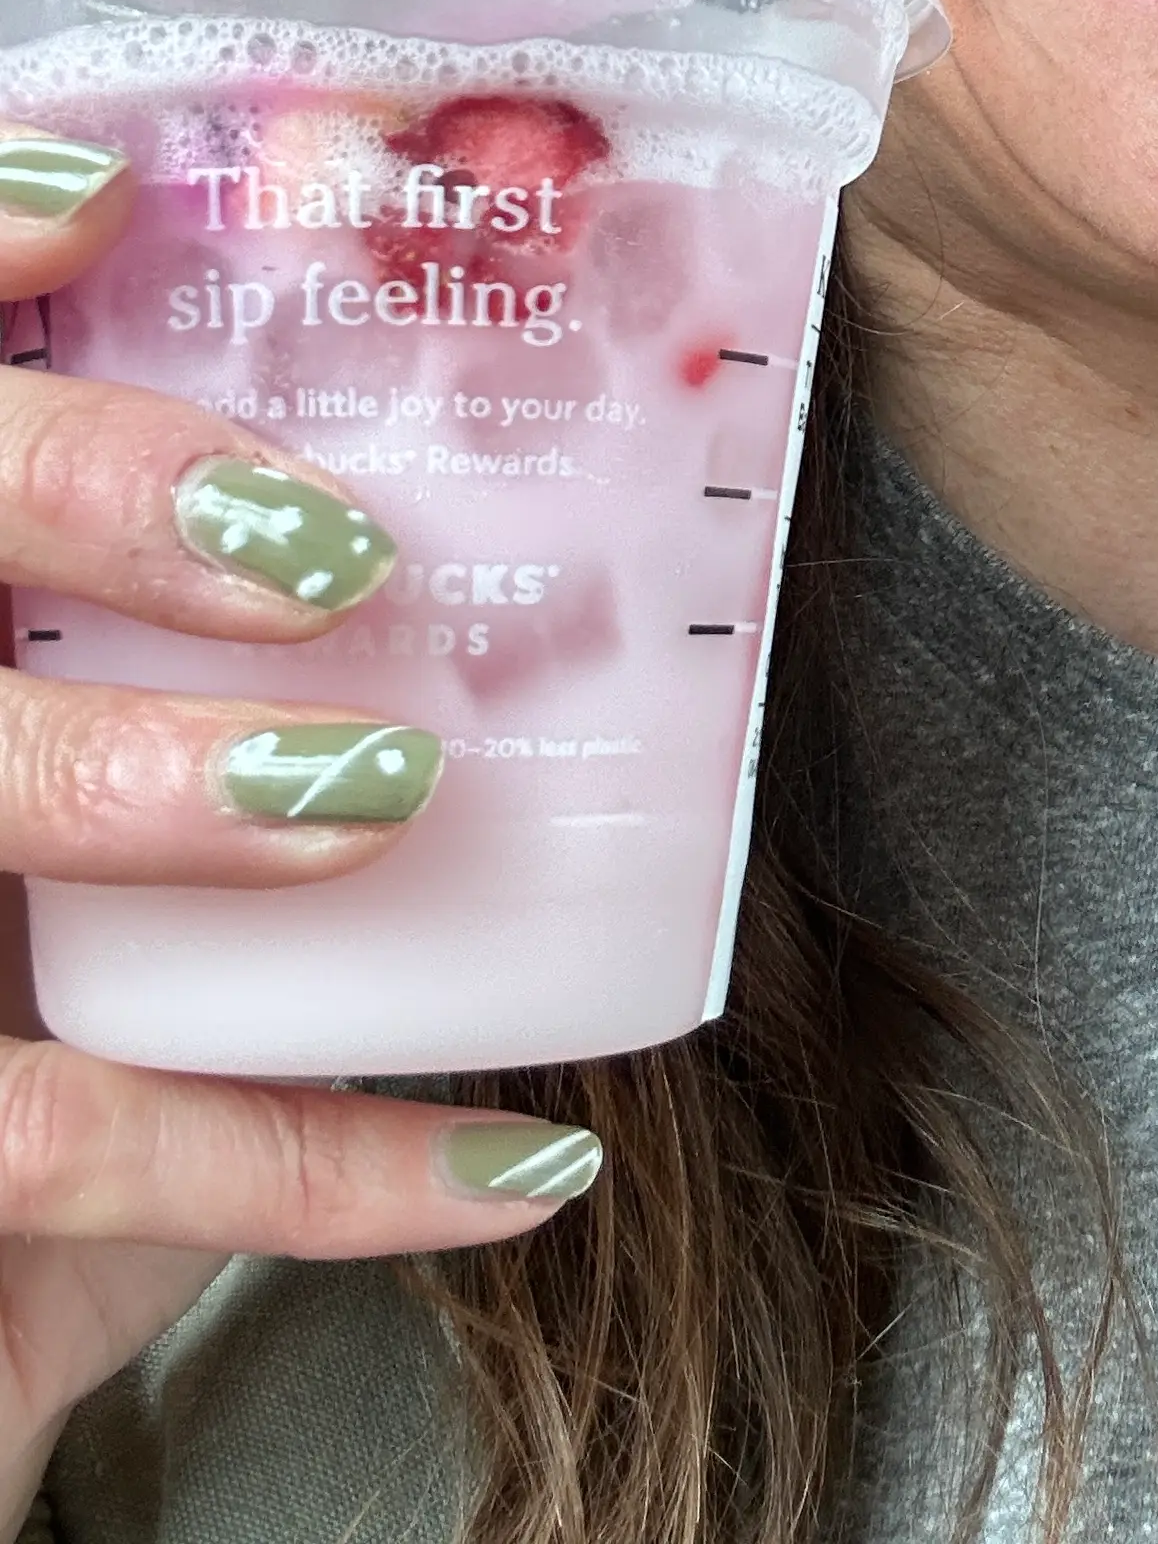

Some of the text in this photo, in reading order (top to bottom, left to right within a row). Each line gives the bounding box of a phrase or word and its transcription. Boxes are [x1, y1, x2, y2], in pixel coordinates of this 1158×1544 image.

[188, 164, 564, 234] That first
[168, 262, 583, 347] sip feeling.
[267, 396, 287, 419] a
[296, 387, 378, 418] little
[384, 387, 444, 427] joy
[454, 392, 492, 419] to
[501, 397, 576, 427] your
[585, 394, 647, 430] day.
